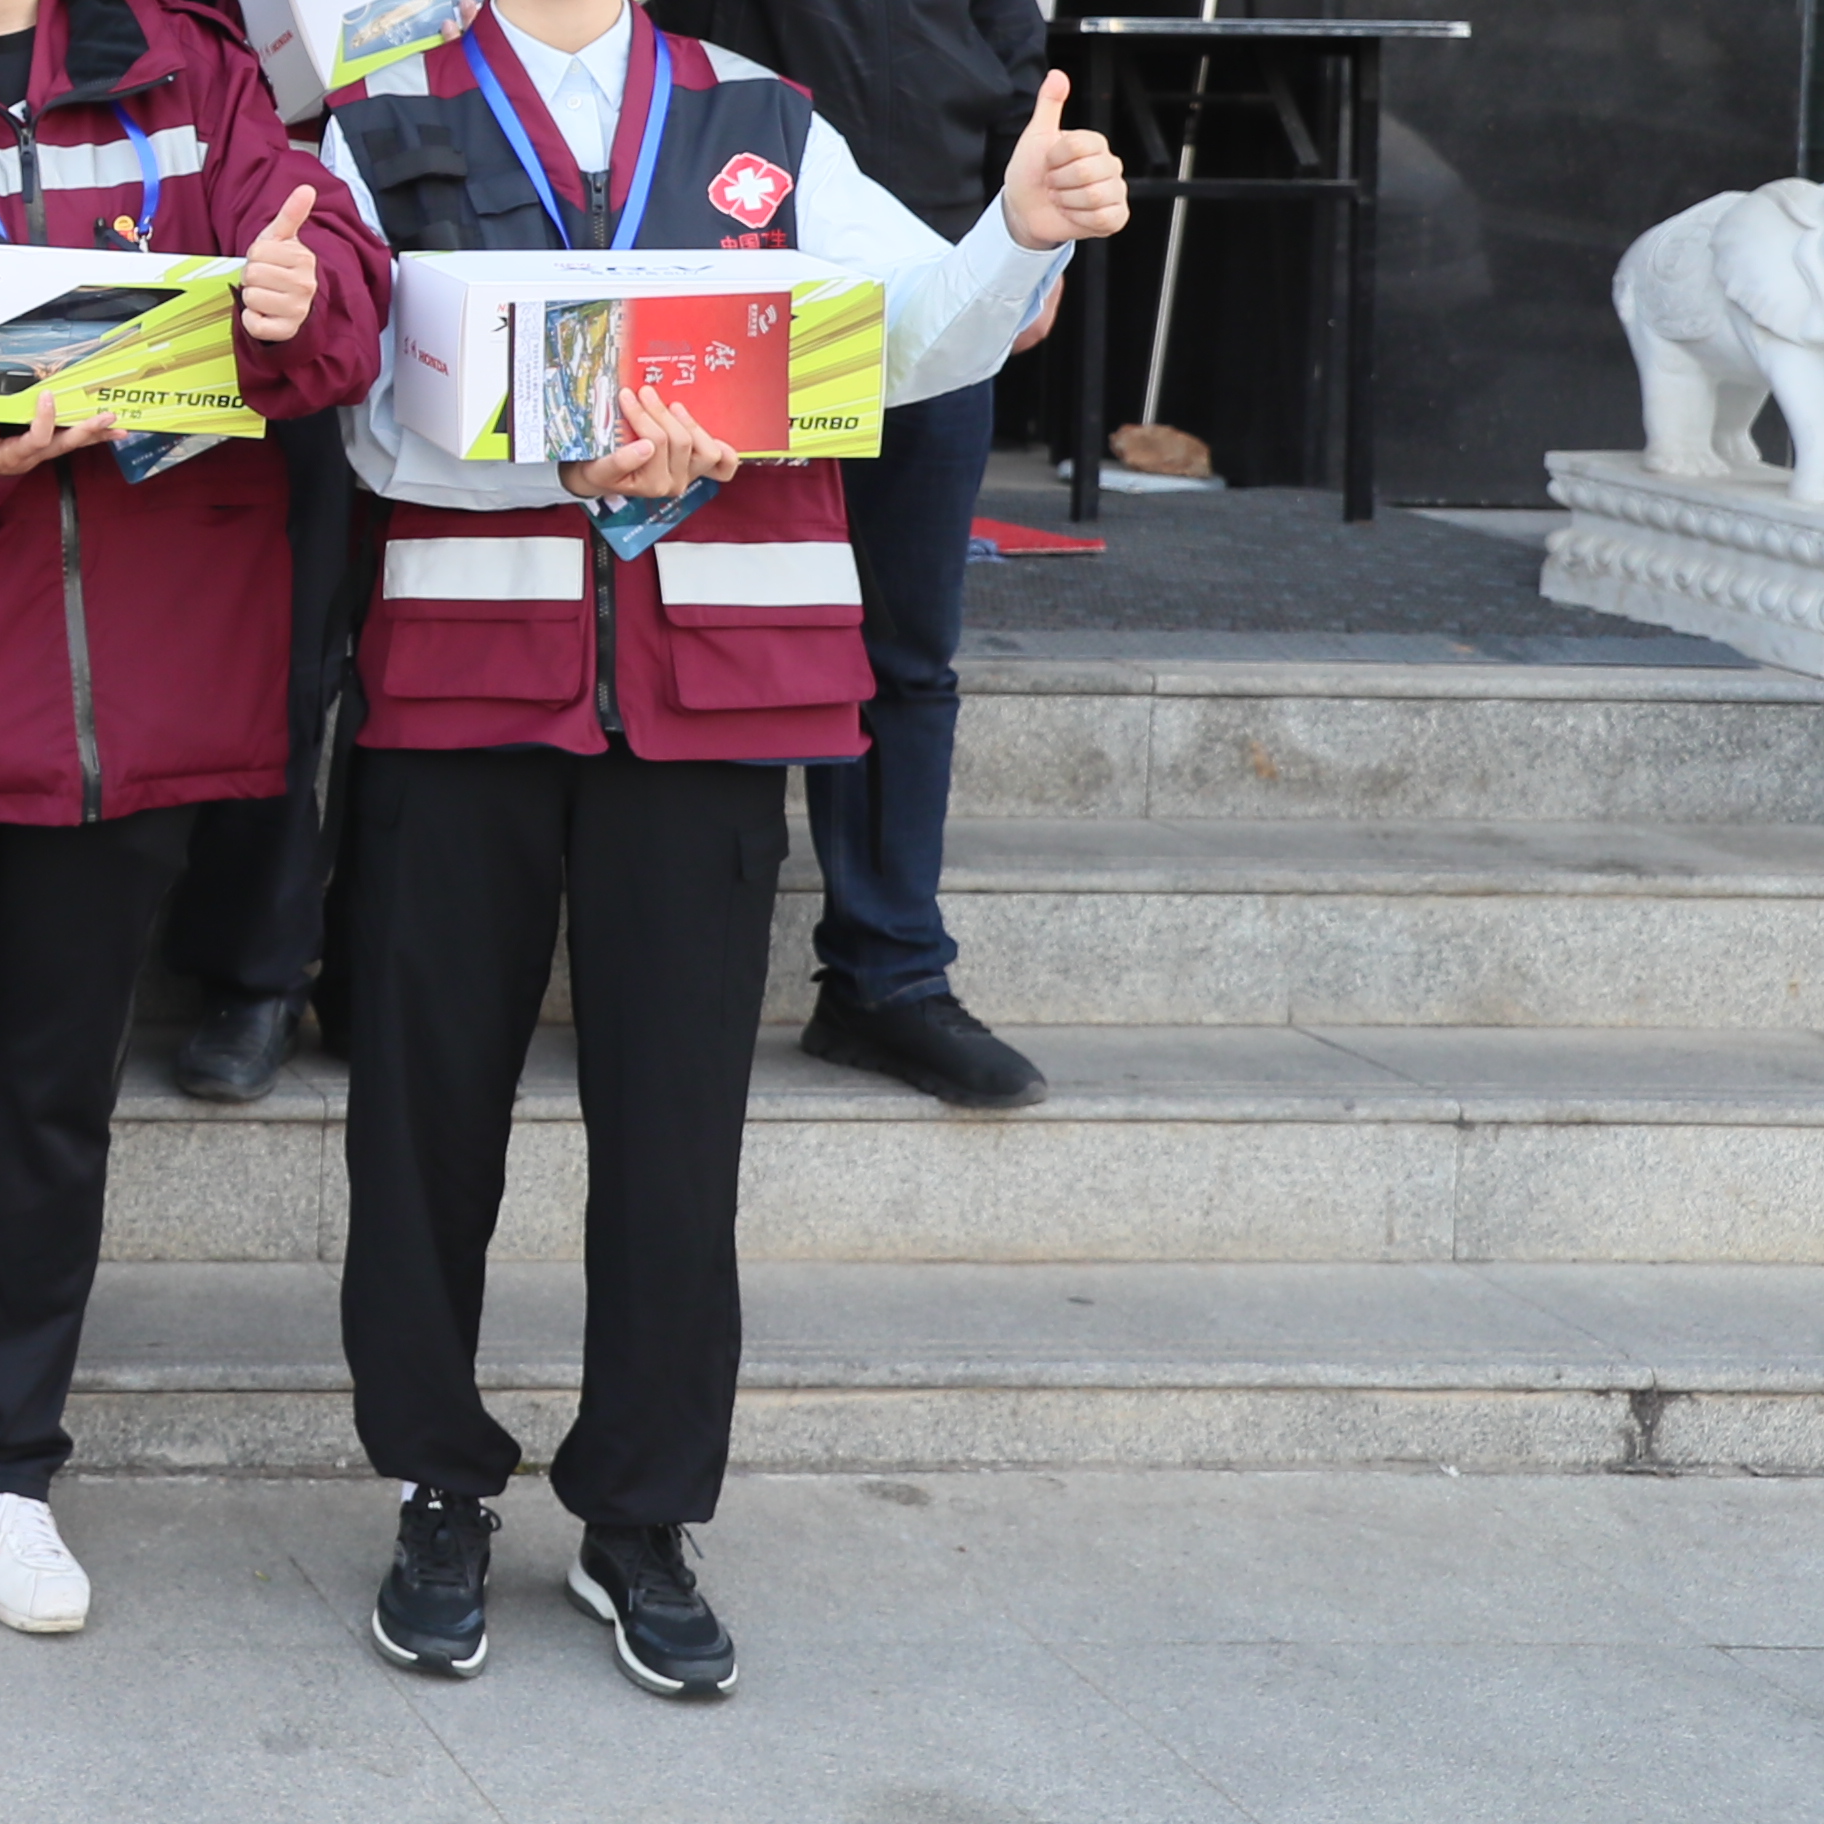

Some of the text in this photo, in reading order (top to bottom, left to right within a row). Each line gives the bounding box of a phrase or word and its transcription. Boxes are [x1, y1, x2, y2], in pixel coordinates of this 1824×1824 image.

[418, 349, 449, 377] HONDA
[97, 387, 245, 409] SPORT TURBO
[789, 416, 859, 431] TURBO
